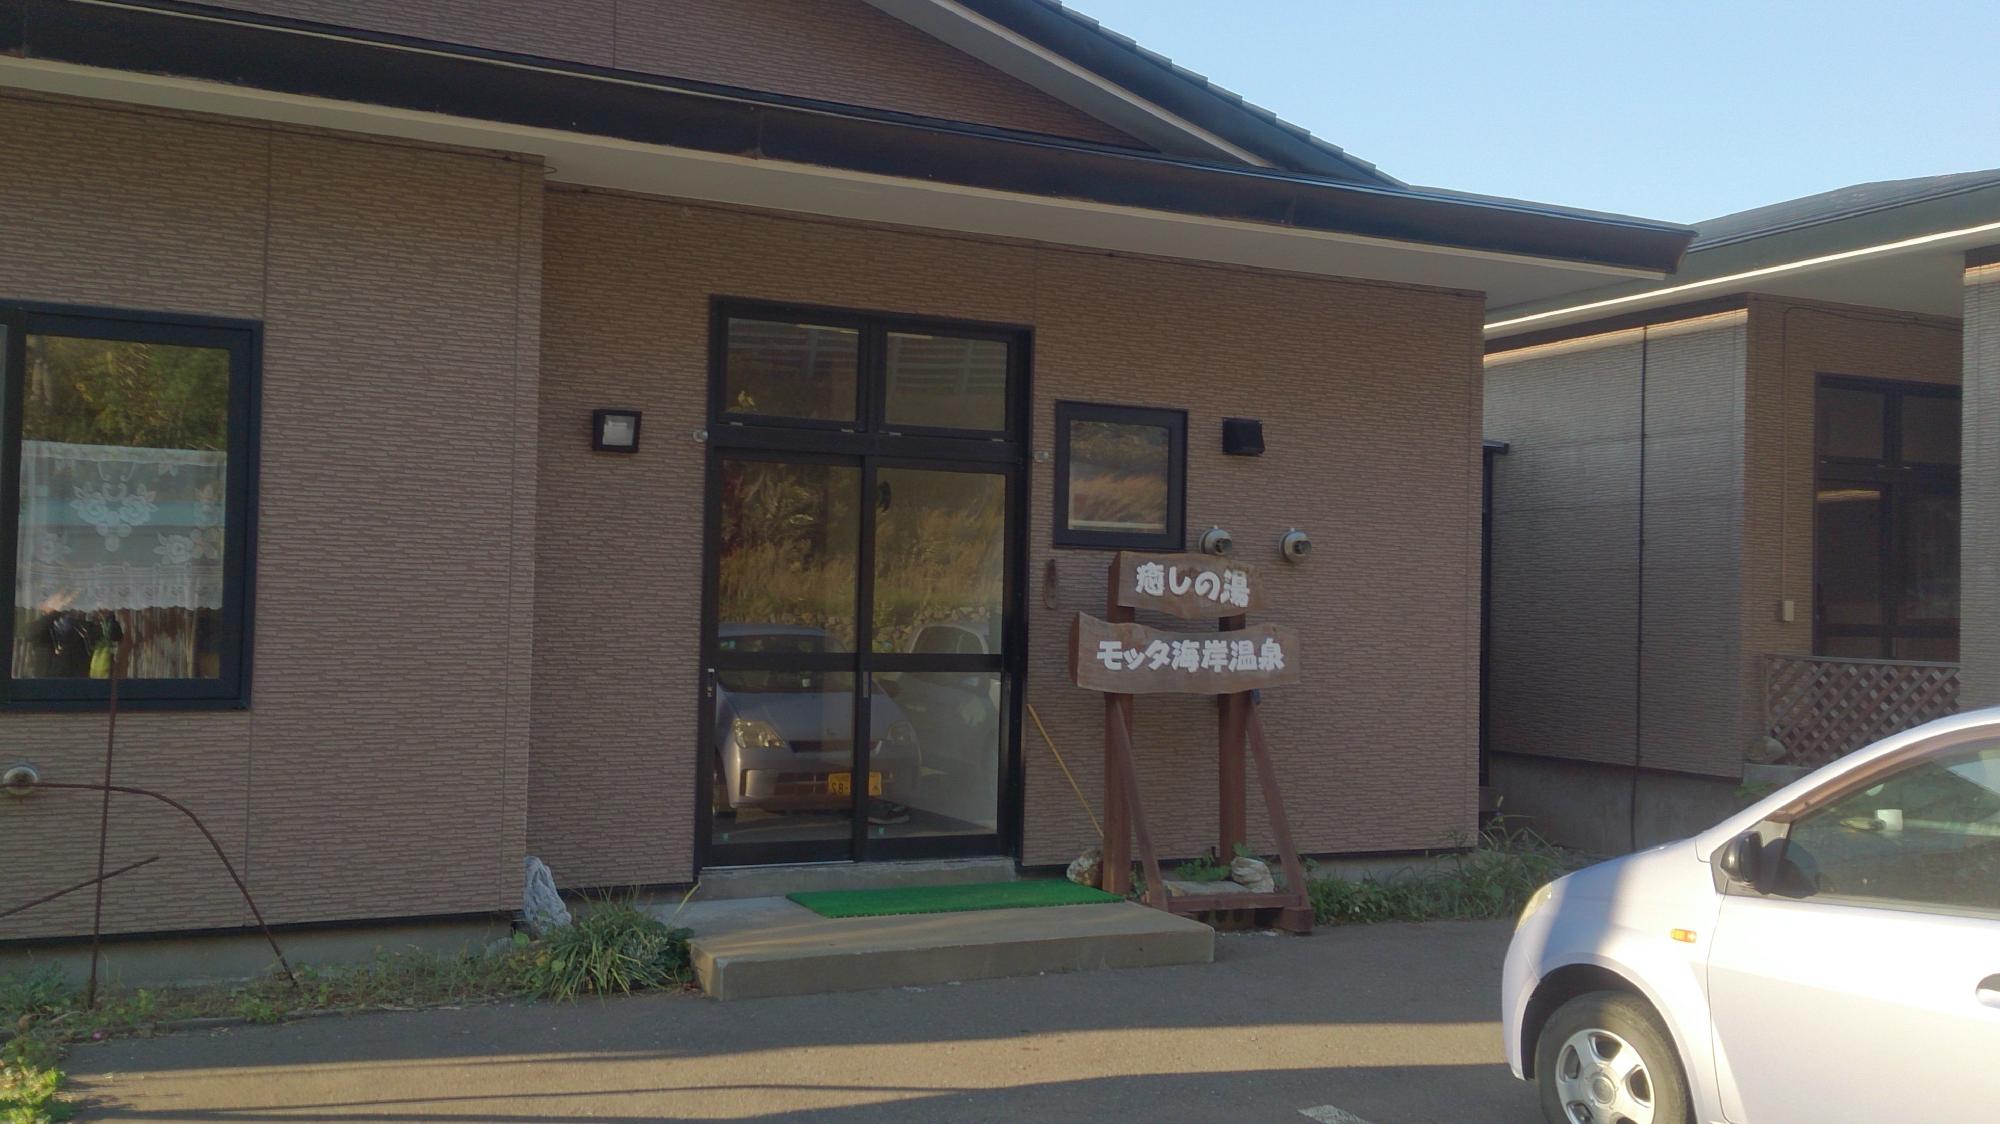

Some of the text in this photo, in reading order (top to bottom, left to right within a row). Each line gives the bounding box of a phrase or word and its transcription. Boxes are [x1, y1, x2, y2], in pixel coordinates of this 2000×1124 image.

[1135, 561, 1250, 608] 癒しの湯
[1096, 637, 1286, 673] モッタ海岸温泉
